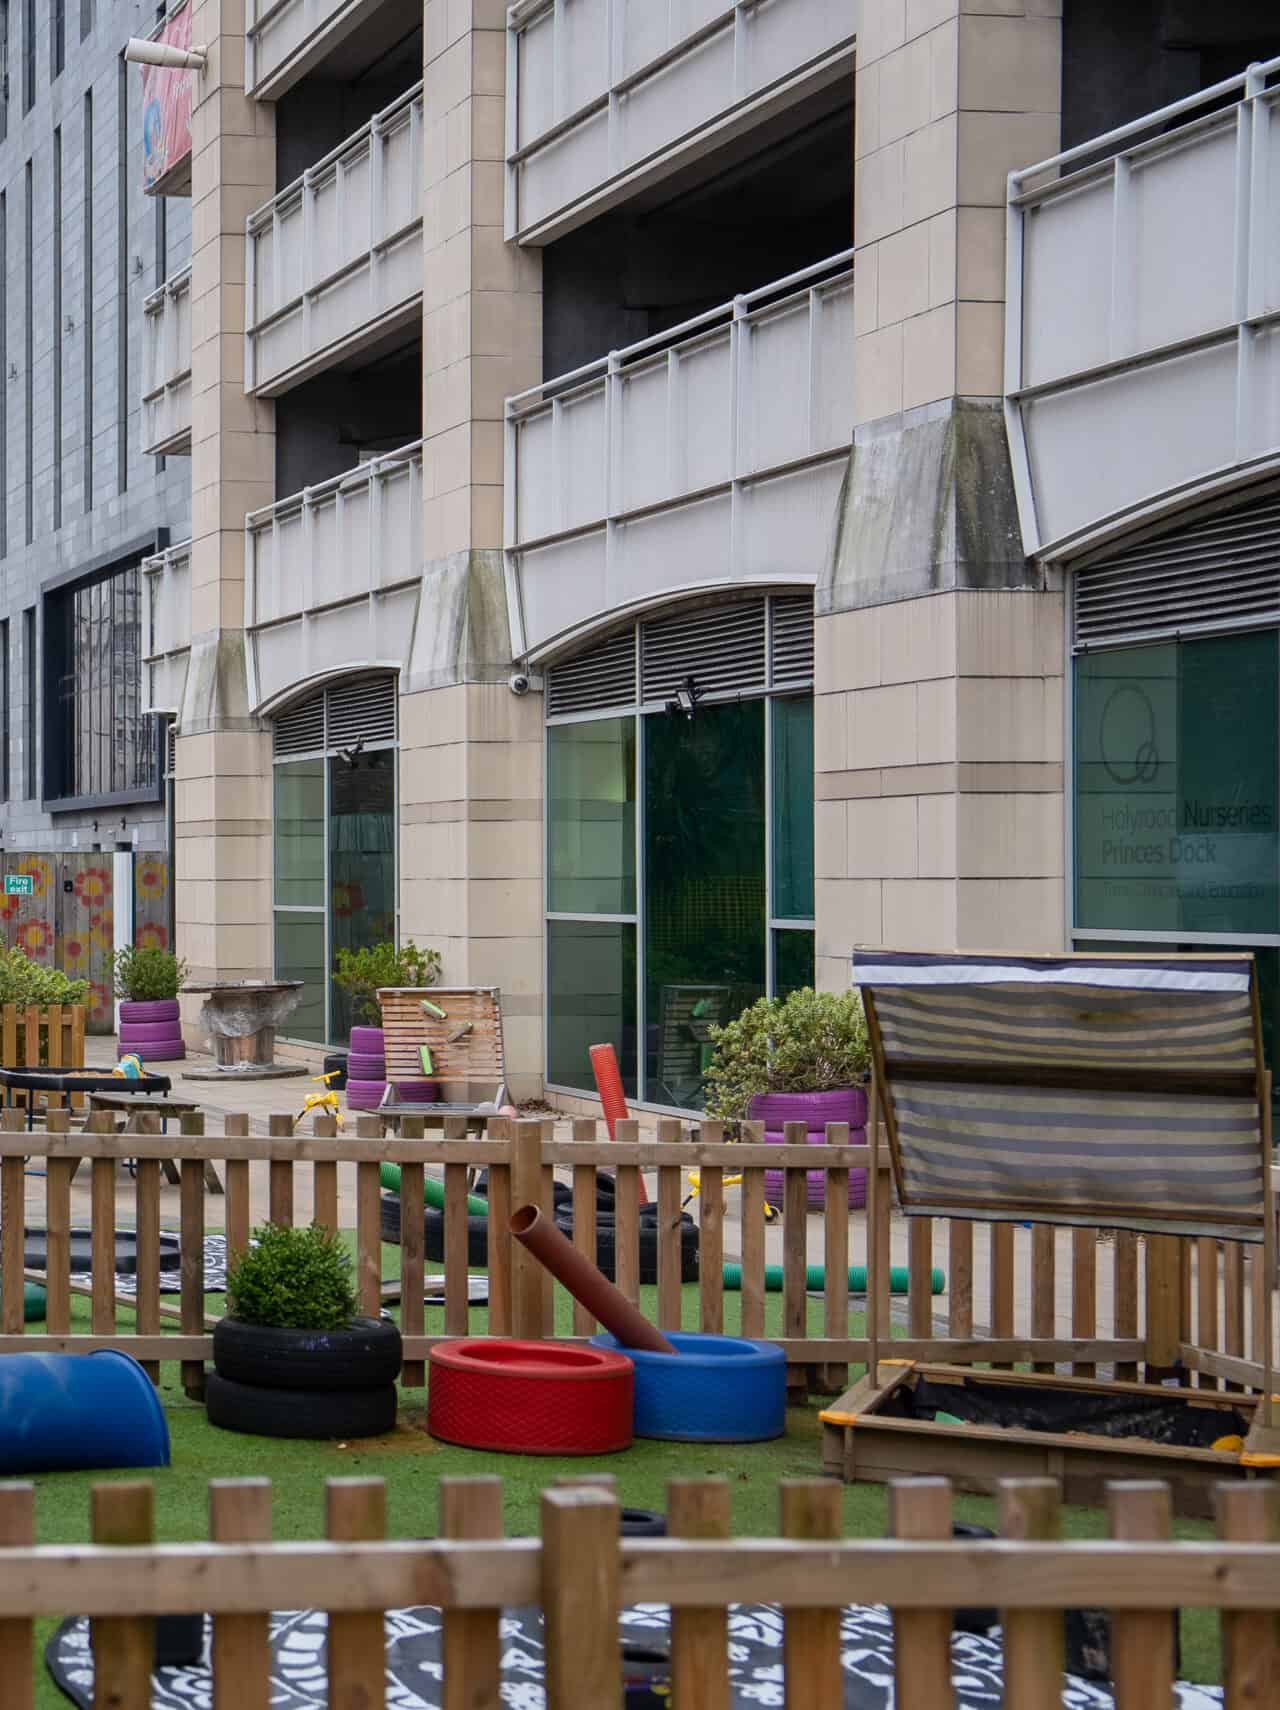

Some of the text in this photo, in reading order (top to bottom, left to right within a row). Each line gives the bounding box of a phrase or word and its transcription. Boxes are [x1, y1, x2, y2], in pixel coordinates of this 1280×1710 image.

[1184, 800, 1272, 828] Nurseries
[1102, 837, 1217, 864] Princes Dock
